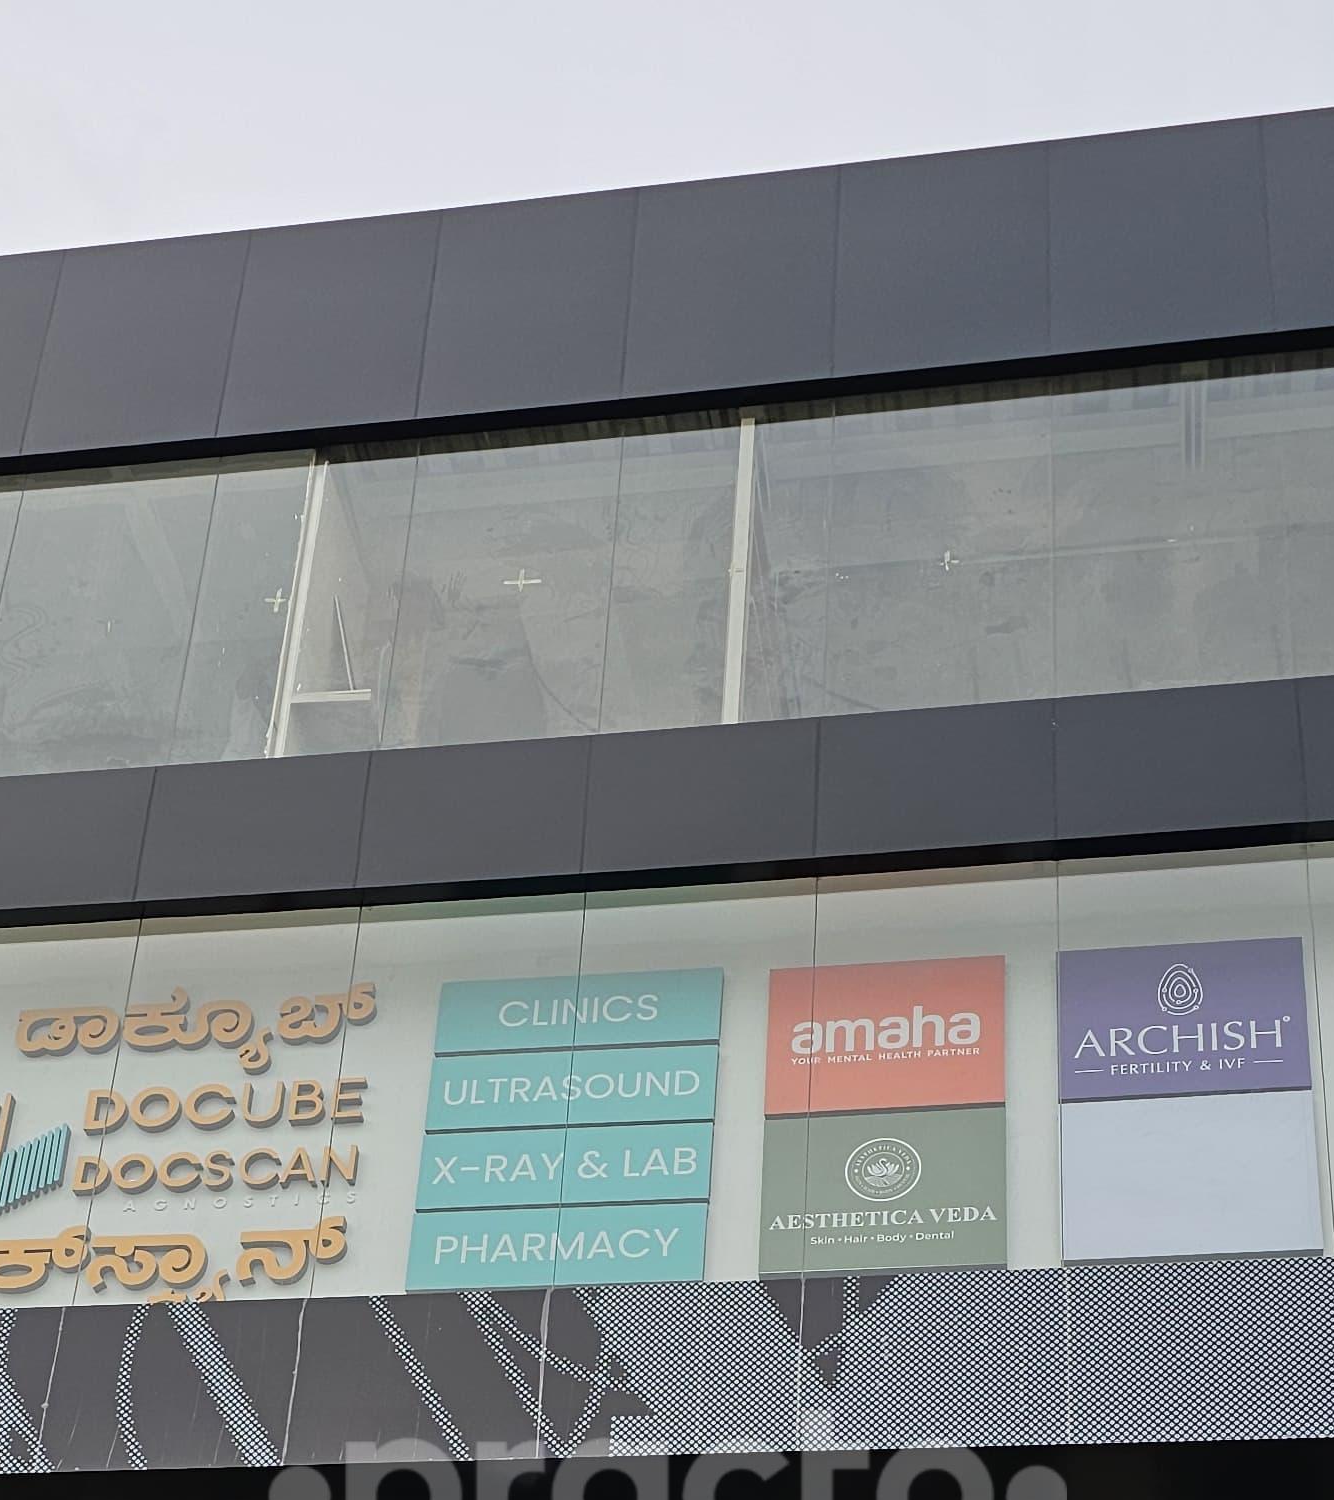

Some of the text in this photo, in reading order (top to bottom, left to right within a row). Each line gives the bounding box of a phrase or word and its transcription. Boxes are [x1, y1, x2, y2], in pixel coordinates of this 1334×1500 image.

[498, 993, 659, 1028] CLINICS
[791, 1005, 981, 1054] amaha
[791, 1047, 980, 1066] YOUR MENTAL HEALTH PARTNER
[1110, 1057, 1245, 1076] FERTILITY & IVF
[83, 1076, 368, 1136] DOCUBE
[443, 1069, 700, 1106] ULTRASOUND
[72, 1144, 360, 1198] DOCSCAN
[432, 1147, 698, 1186] X-RAY & LAB
[769, 1205, 998, 1231] AESTHETICA VEDA
[434, 1226, 680, 1265] PHARMACY
[810, 1230, 955, 1246] Skin Hair Body Dental
